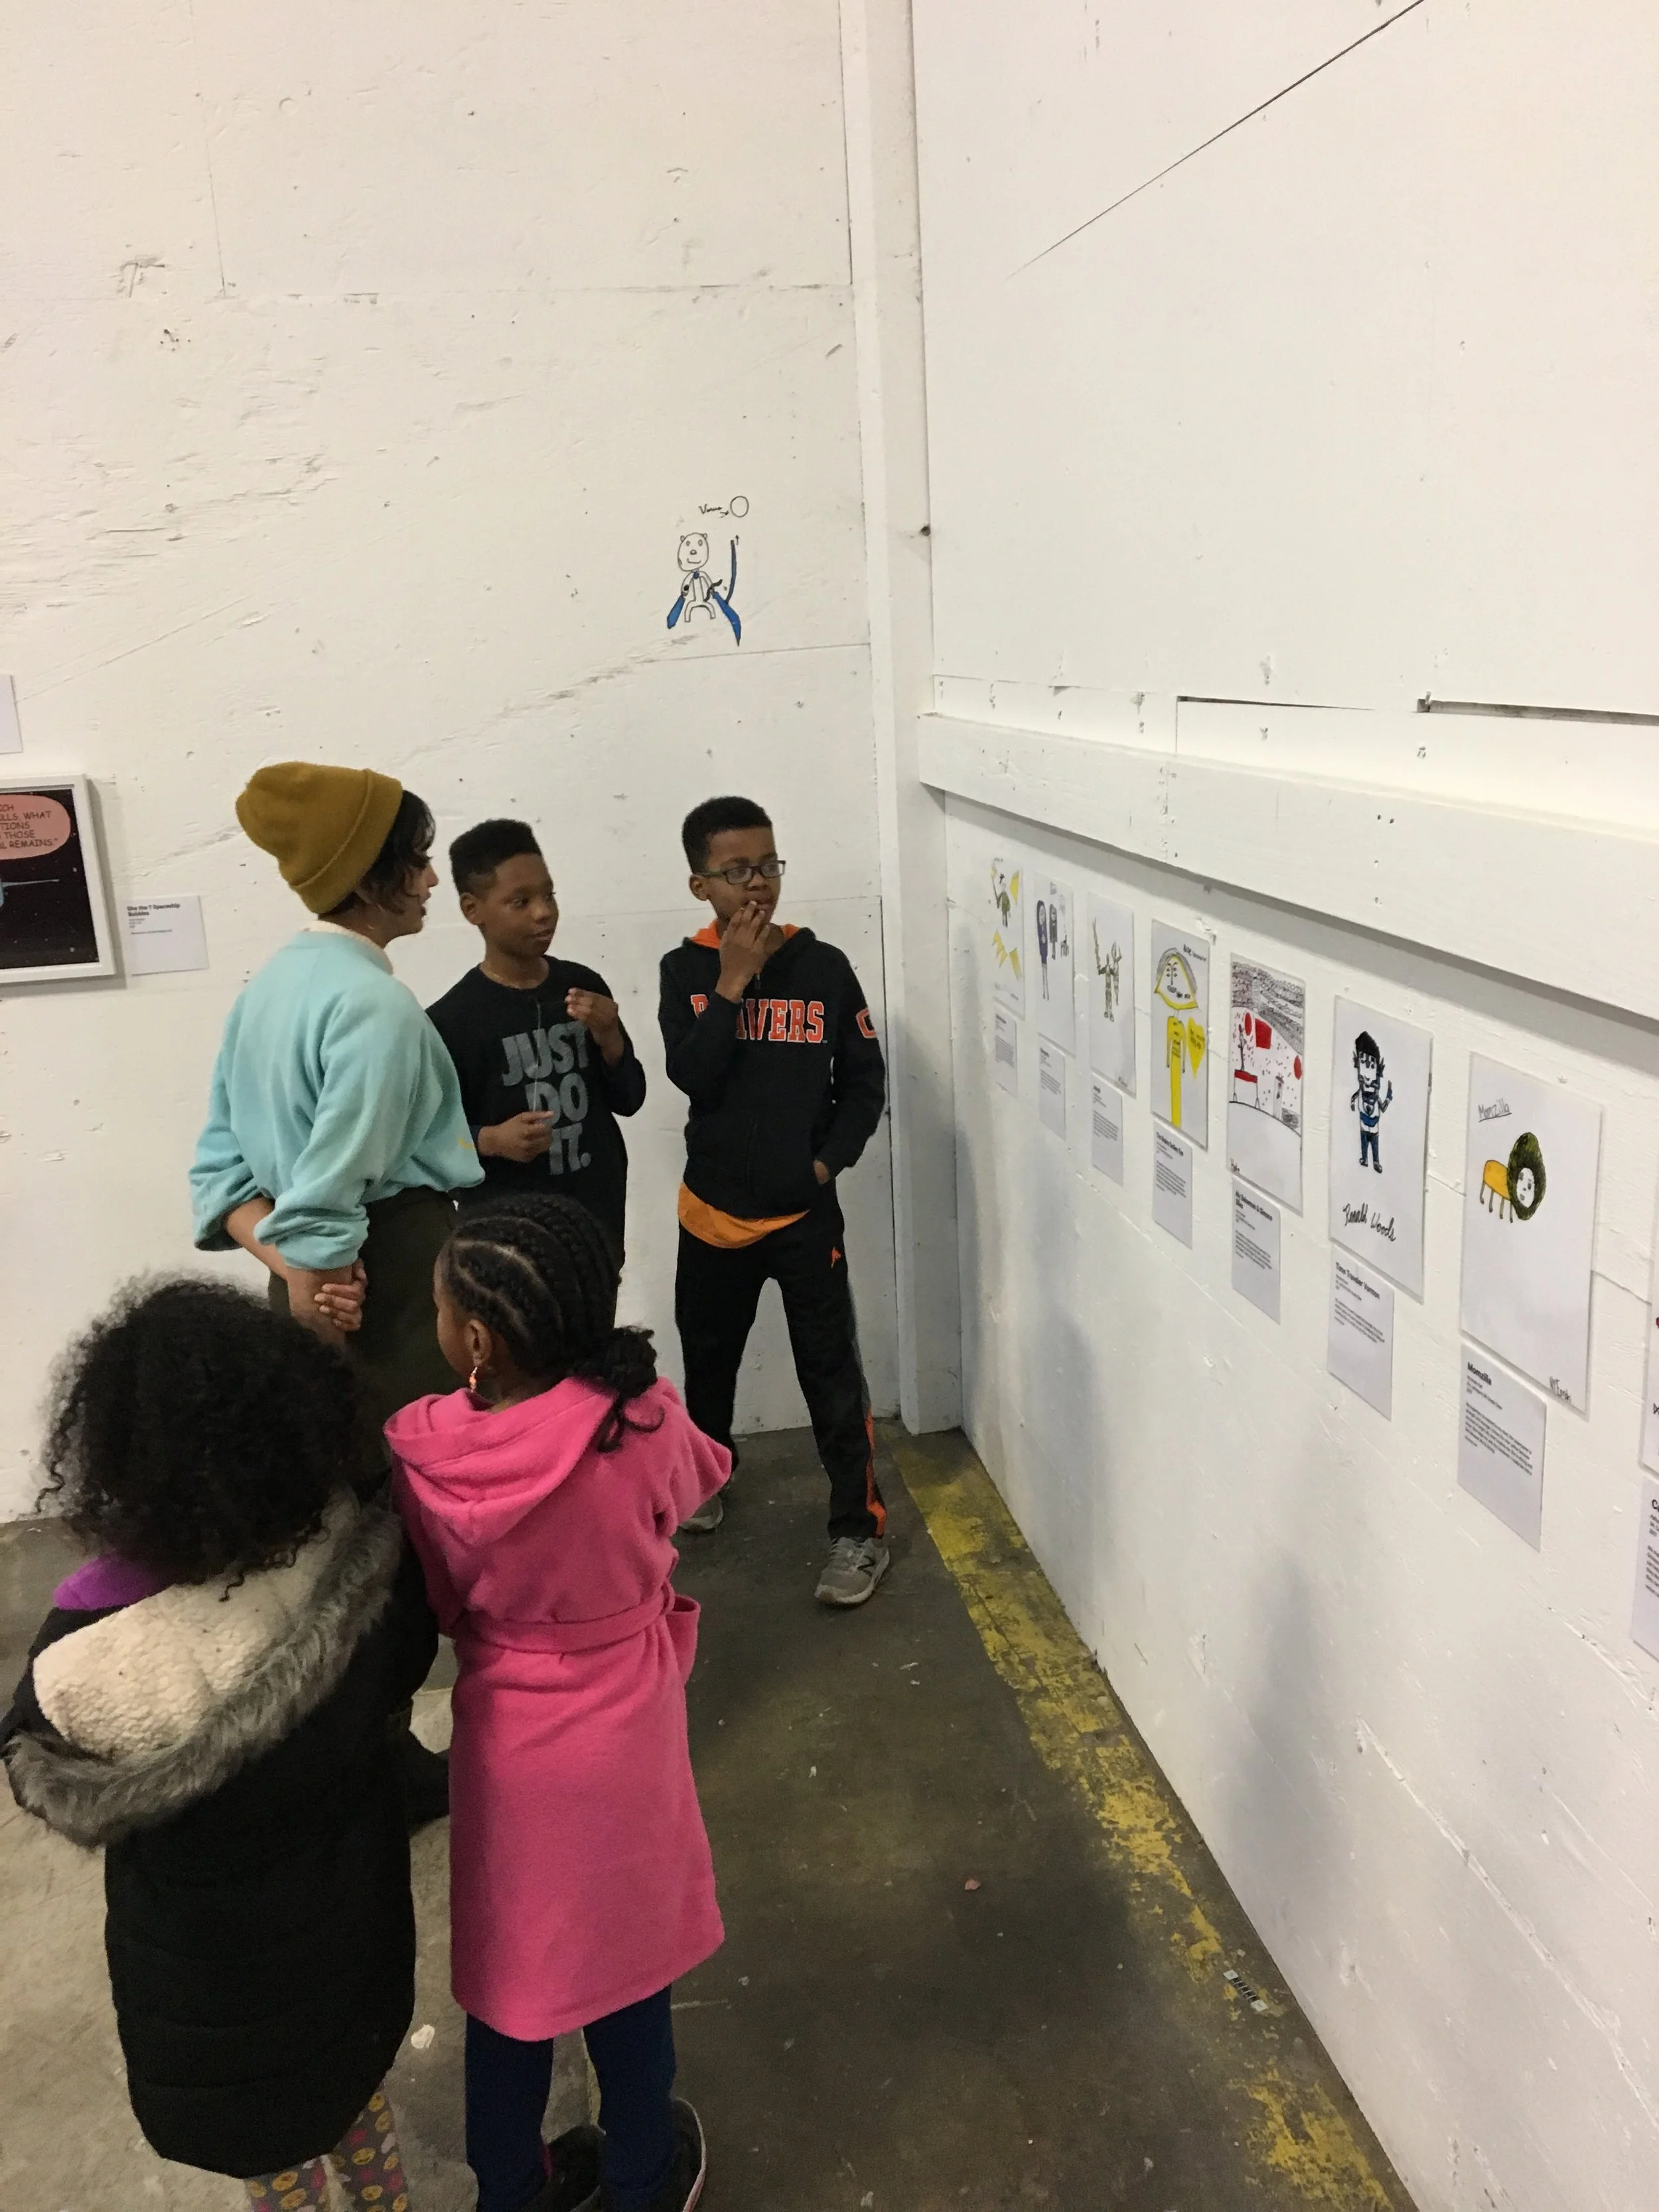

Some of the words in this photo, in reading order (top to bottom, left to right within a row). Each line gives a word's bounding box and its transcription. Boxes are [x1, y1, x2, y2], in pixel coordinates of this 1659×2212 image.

[24, 810, 52, 820] WHAT
[4, 830, 35, 839] THOSE
[502, 1021, 589, 1086] JUST
[524, 1072, 588, 1127] DO
[1467, 1362, 1492, 1385] Momzilla
